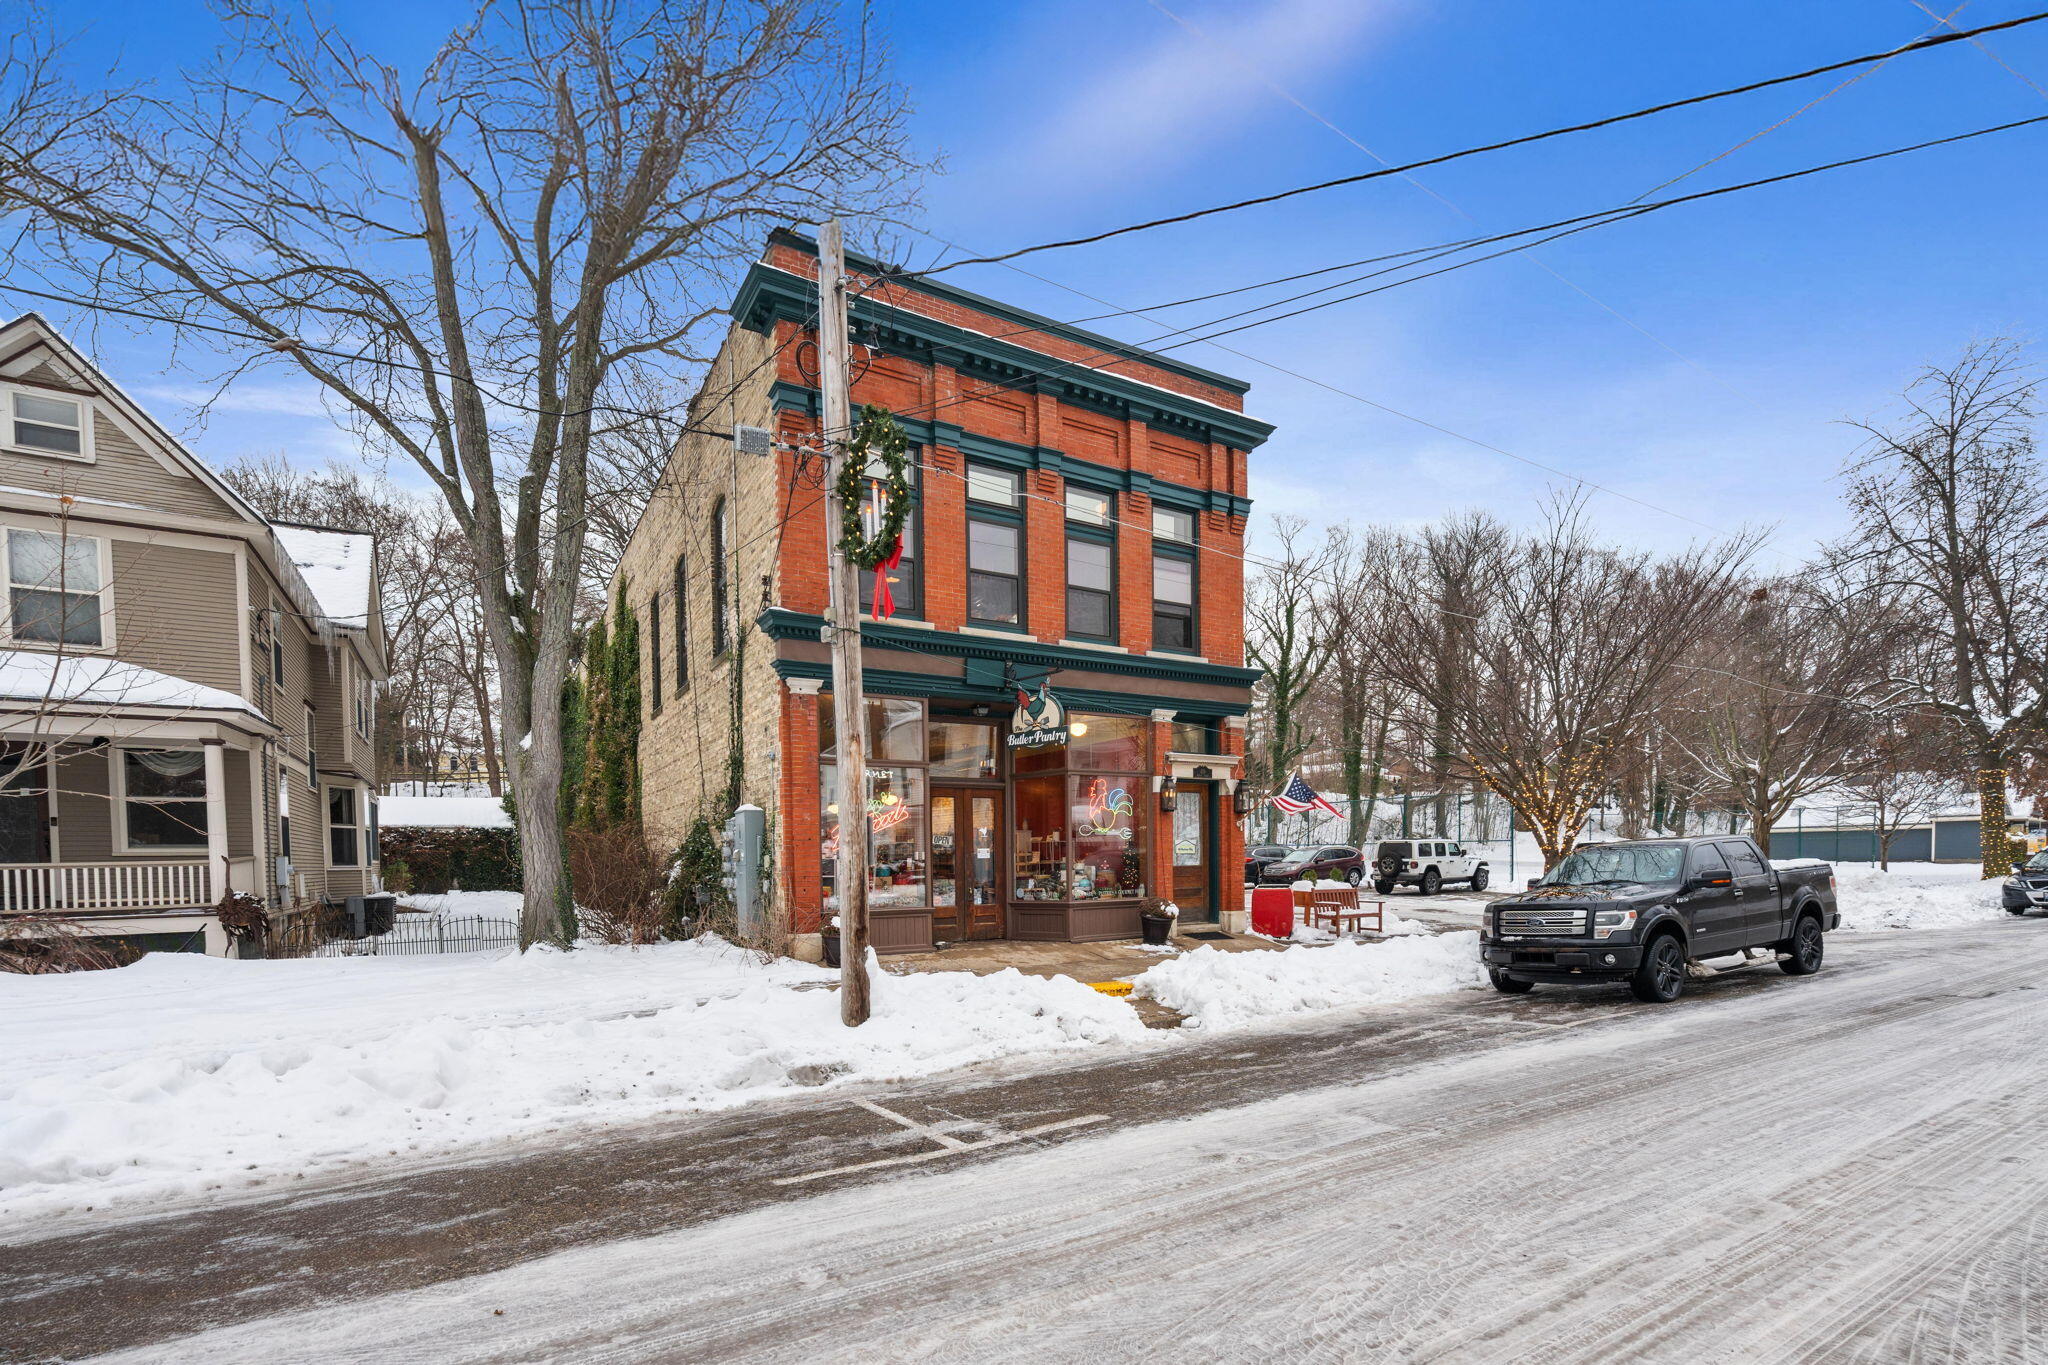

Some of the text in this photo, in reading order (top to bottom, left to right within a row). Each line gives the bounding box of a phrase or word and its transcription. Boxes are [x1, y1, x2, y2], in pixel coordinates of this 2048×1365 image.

[1007, 730, 1067, 746] Butler Pantry
[864, 769, 893, 778] RMET
[933, 835, 950, 845] OPEN
